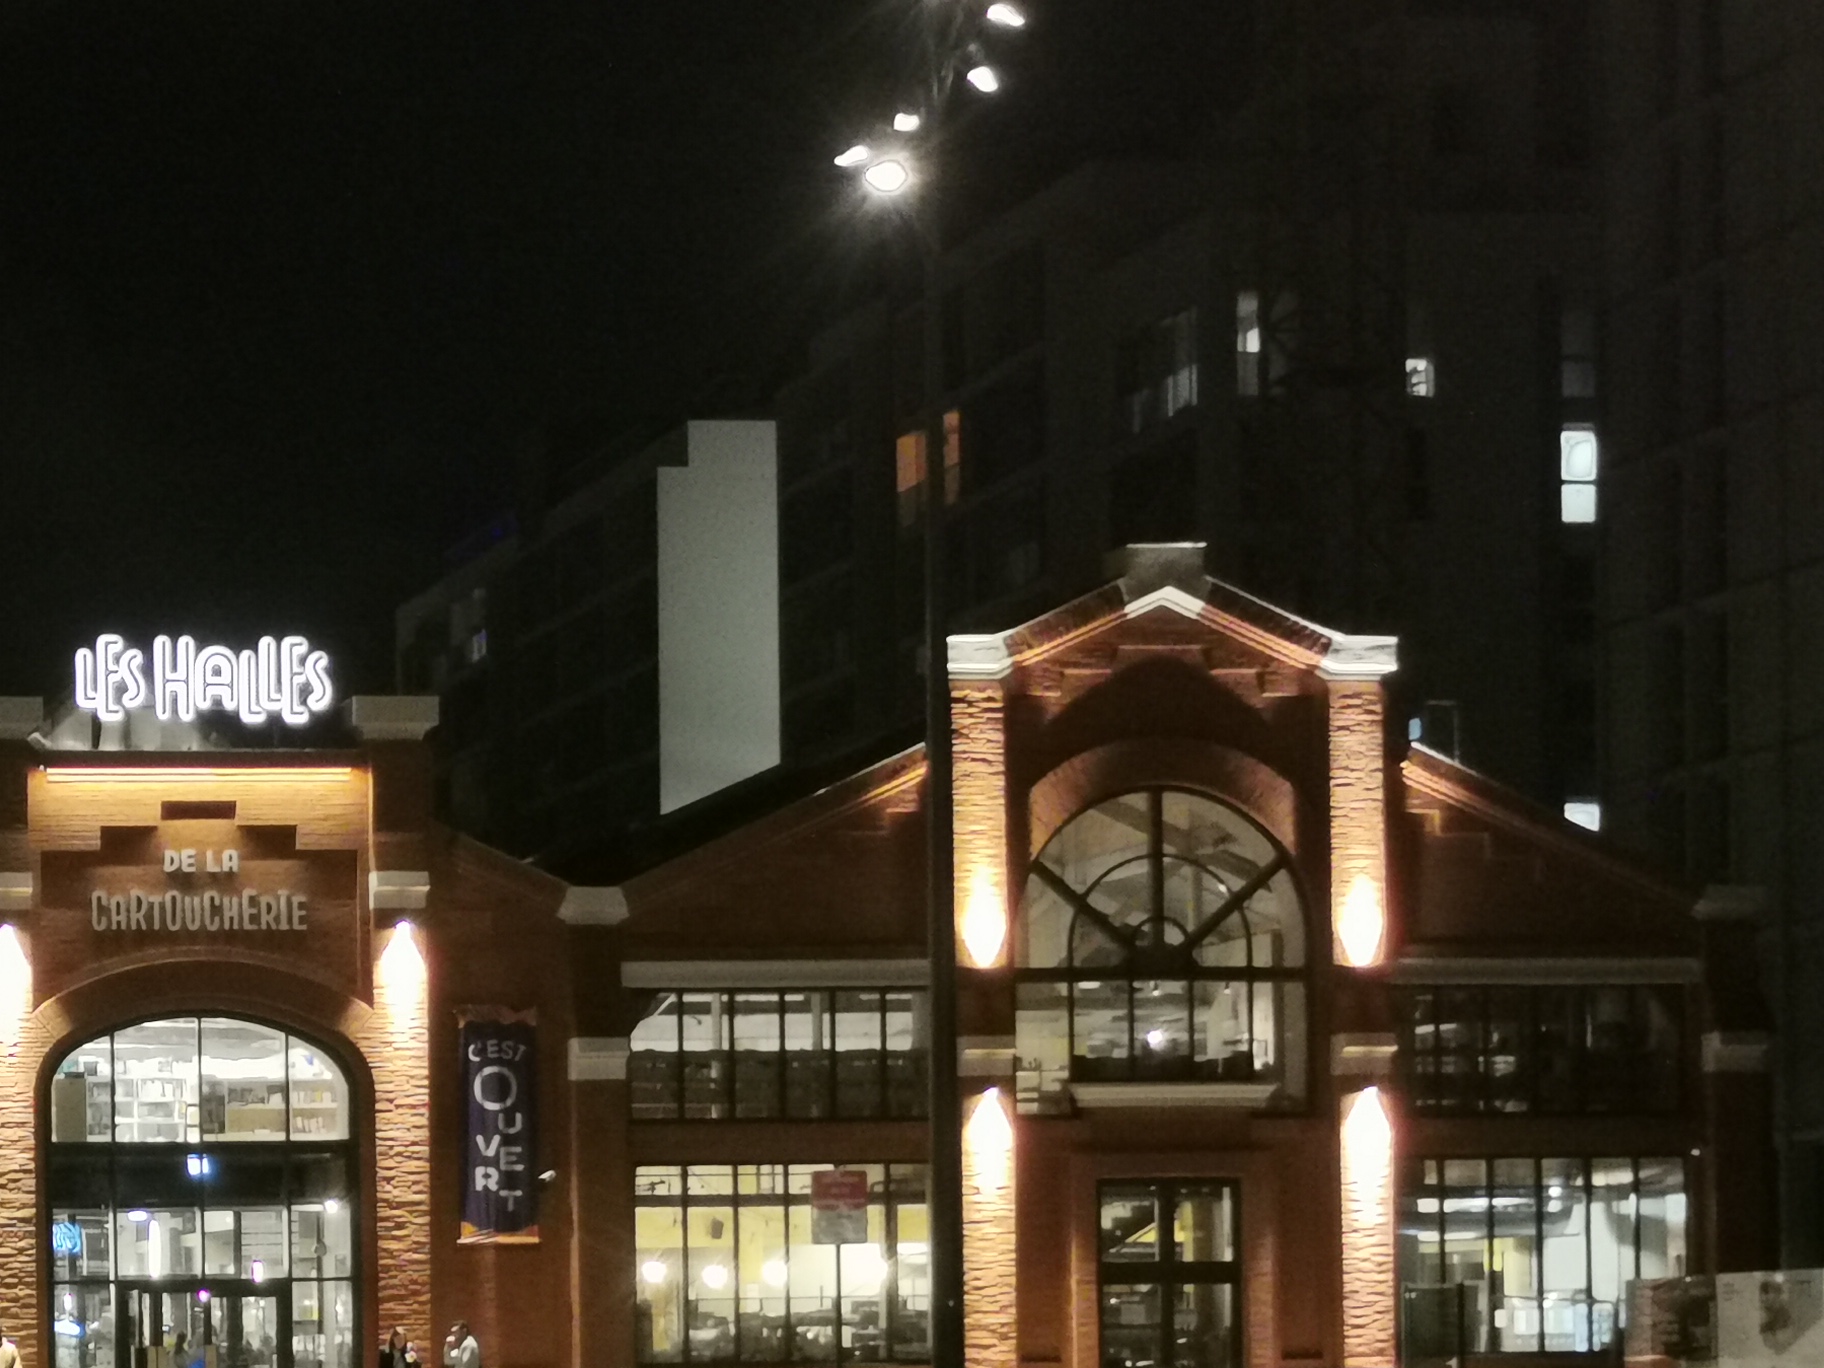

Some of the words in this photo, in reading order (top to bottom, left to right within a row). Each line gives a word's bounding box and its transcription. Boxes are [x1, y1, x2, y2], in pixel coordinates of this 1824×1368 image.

[74, 633, 146, 723] LES
[152, 634, 334, 725] HALLES
[163, 848, 196, 872] DE
[205, 849, 239, 874] LA
[91, 890, 308, 932] CARTOUCHERIE
[468, 1039, 526, 1063] C'EST
